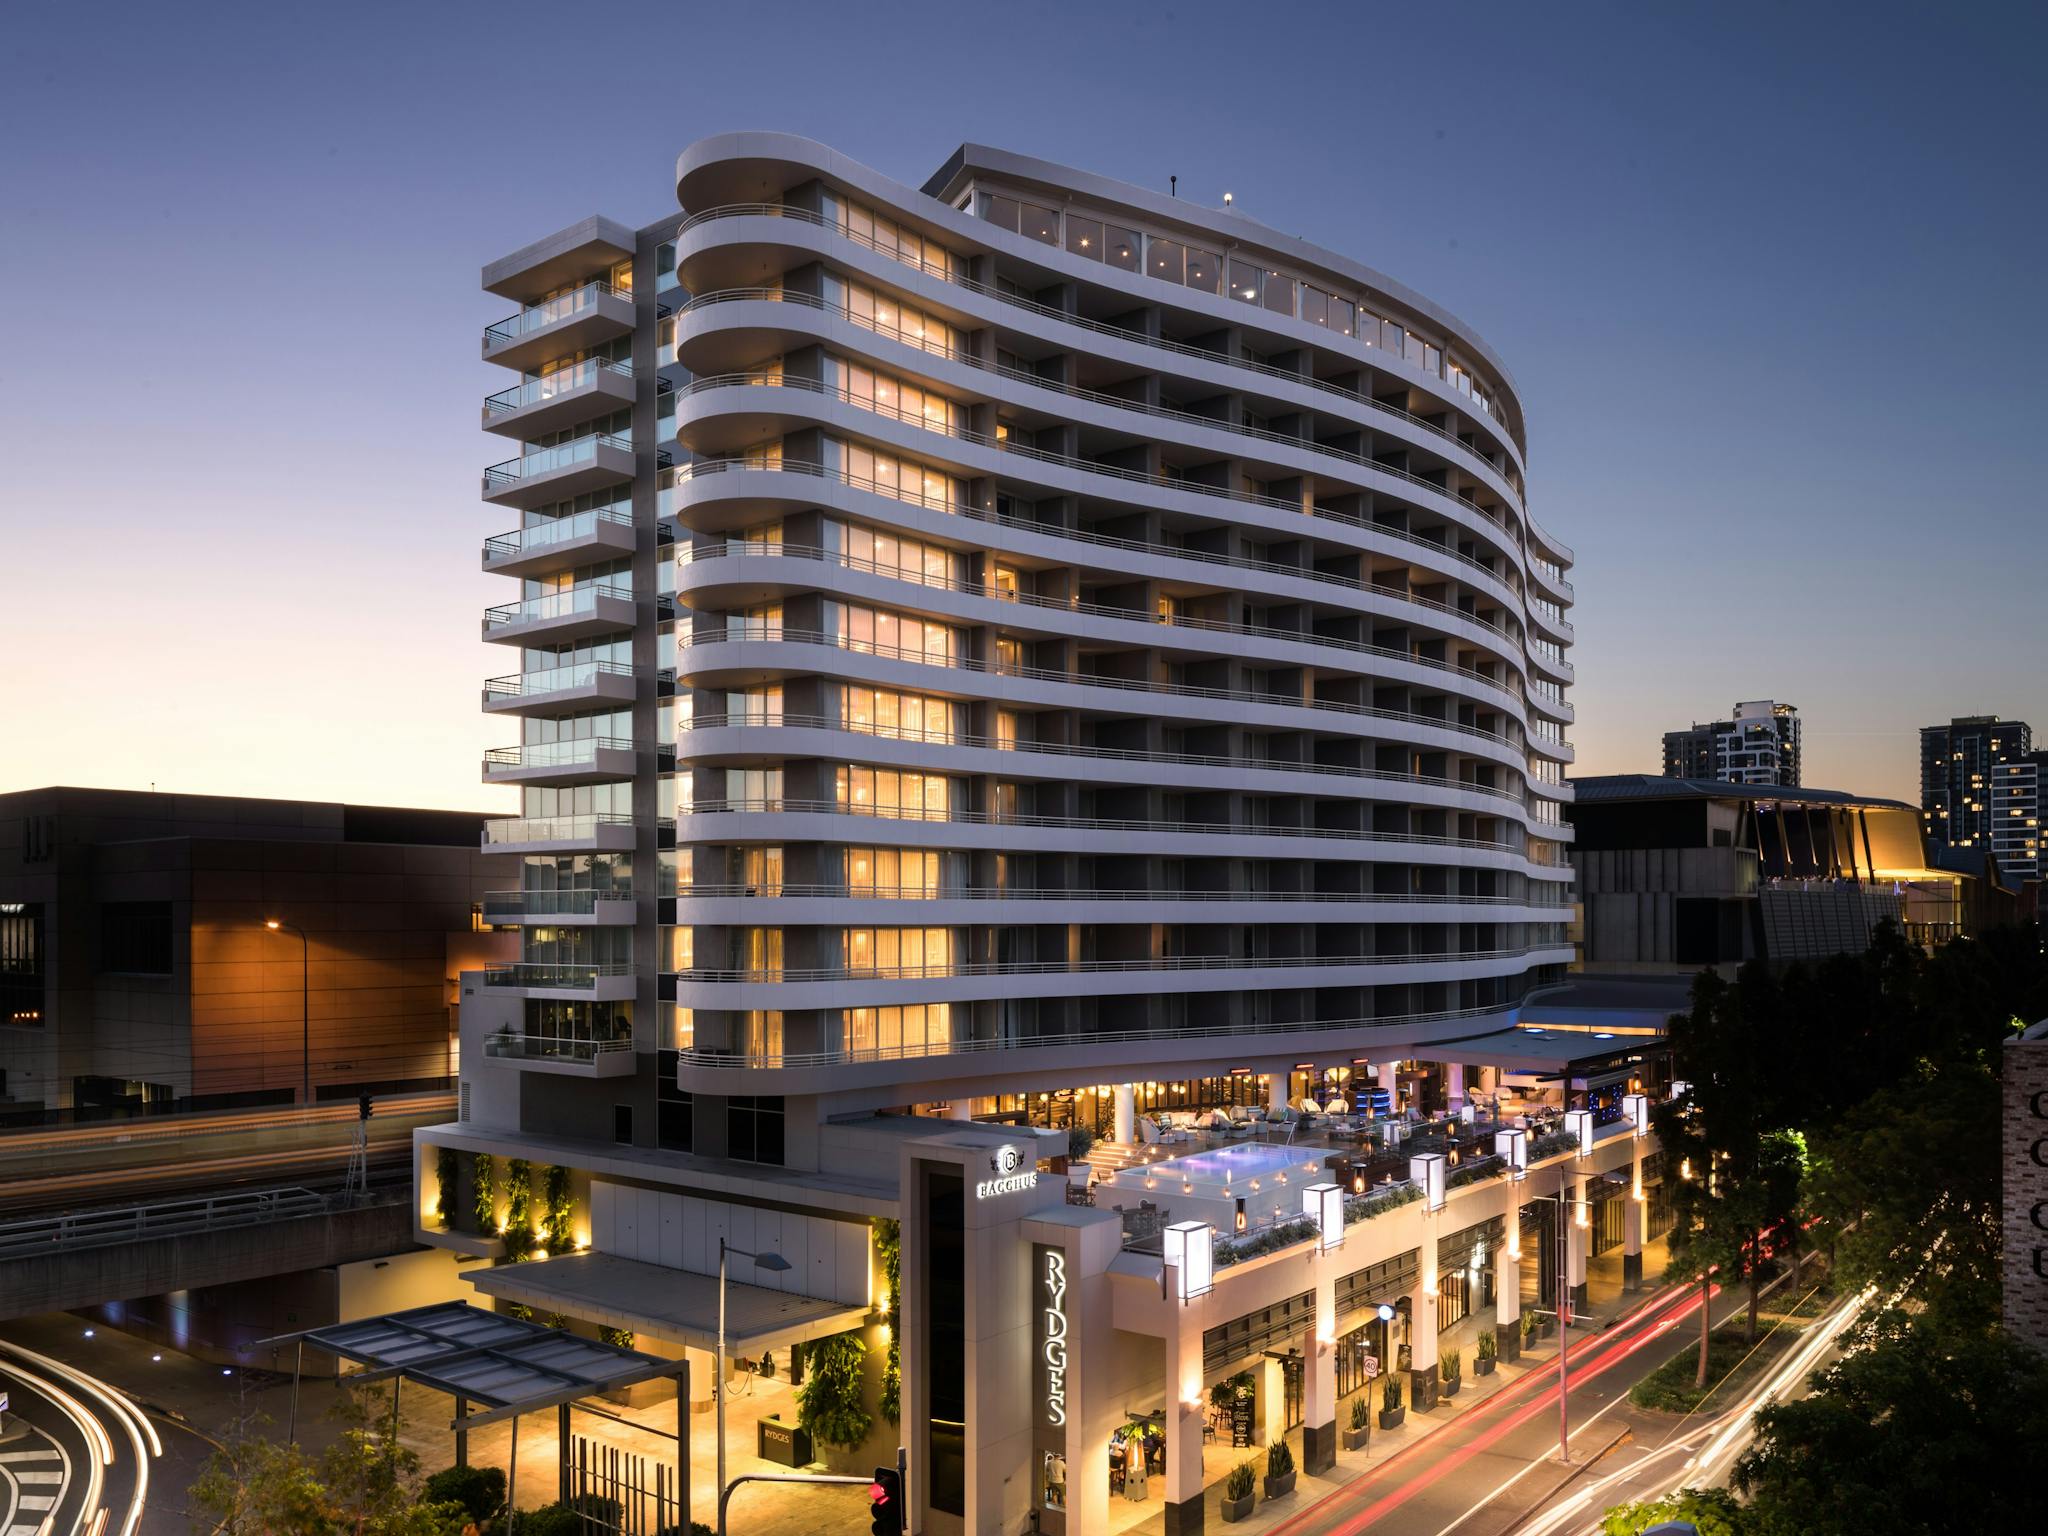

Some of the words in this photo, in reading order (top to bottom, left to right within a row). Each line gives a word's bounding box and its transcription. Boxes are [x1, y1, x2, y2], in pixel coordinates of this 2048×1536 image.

[979, 1173, 1037, 1197] BACCHUS
[1044, 1251, 1067, 1426] RYDGES
[764, 1429, 790, 1443] RYDGES
